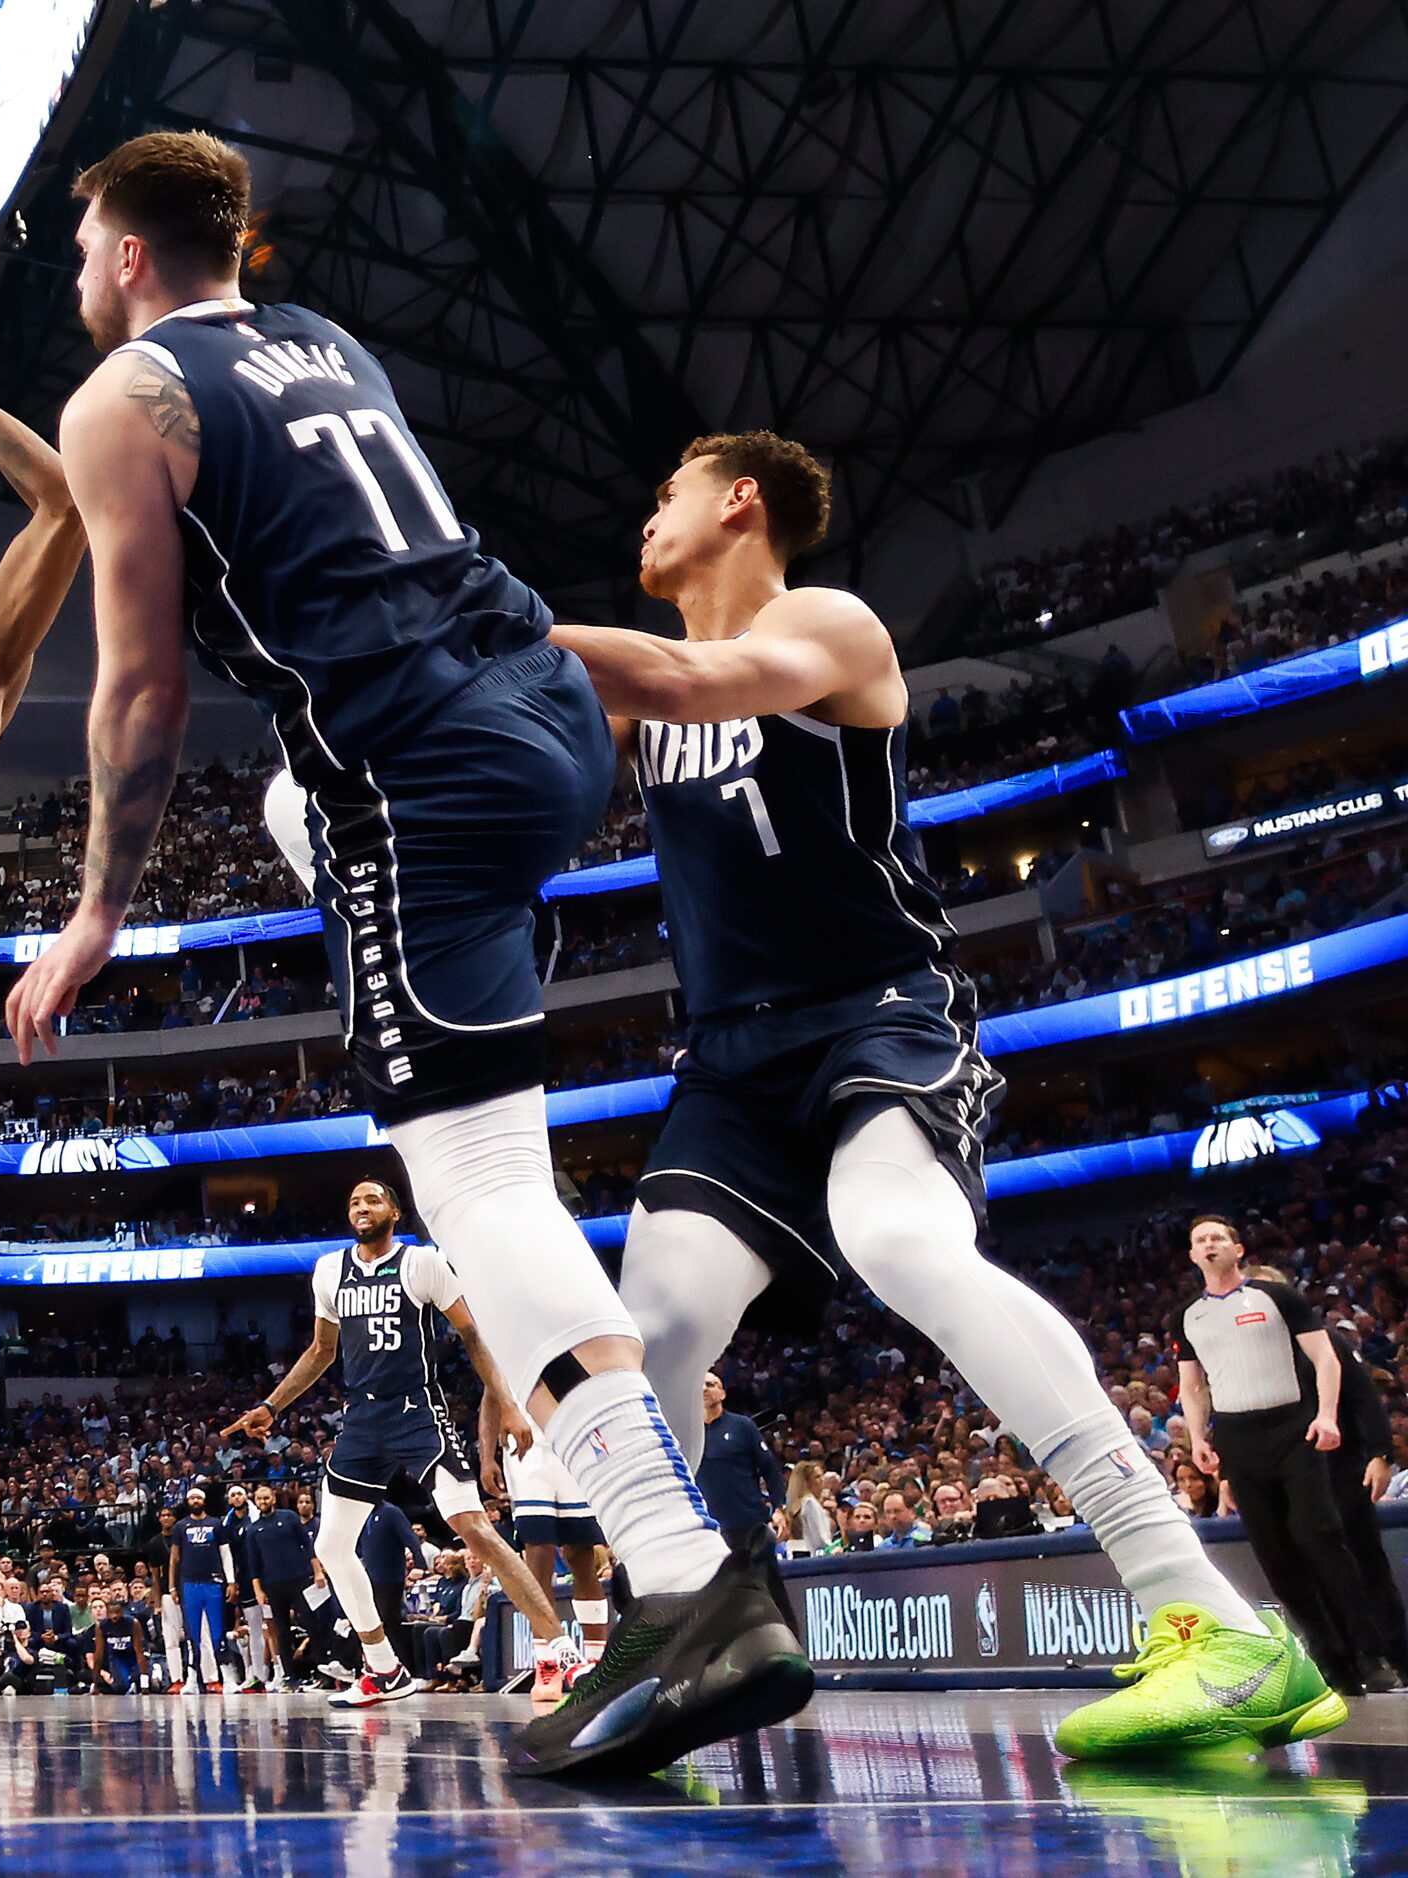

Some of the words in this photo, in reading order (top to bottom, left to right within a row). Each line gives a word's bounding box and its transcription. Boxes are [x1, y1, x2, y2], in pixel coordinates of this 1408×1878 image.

[233, 340, 356, 397] DONČIĆ
[286, 408, 464, 553] 77
[639, 716, 764, 787] MAVS
[720, 777, 781, 857] 7
[1253, 804, 1337, 837] MUSTANG
[1337, 792, 1383, 817] CLUB
[350, 861, 414, 1086] MAVERICKS
[1118, 944, 1314, 1029] DEFENSE
[42, 1250, 205, 1284] DEFENSE
[338, 1284, 401, 1317] MAVS
[368, 1317, 401, 1351] 55
[805, 1584, 953, 1661] NBAStore.com
